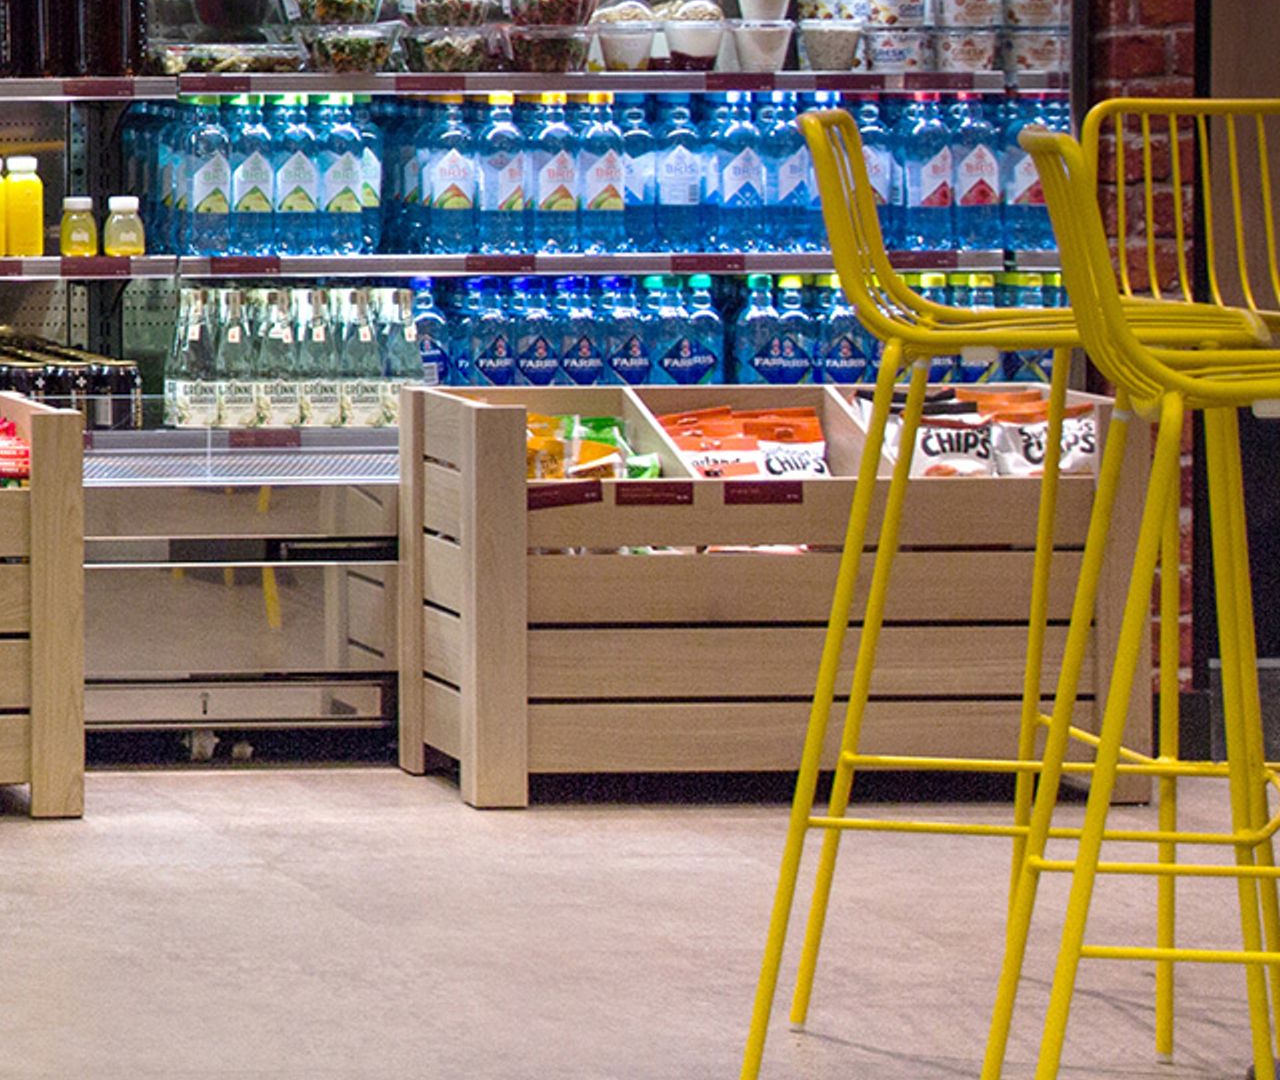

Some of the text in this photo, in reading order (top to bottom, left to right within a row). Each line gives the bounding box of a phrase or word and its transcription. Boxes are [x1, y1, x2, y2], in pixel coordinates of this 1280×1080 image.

[922, 431, 990, 460] CHIPS
[1023, 433, 1096, 466] CPS
[765, 455, 826, 476] CHIPS
